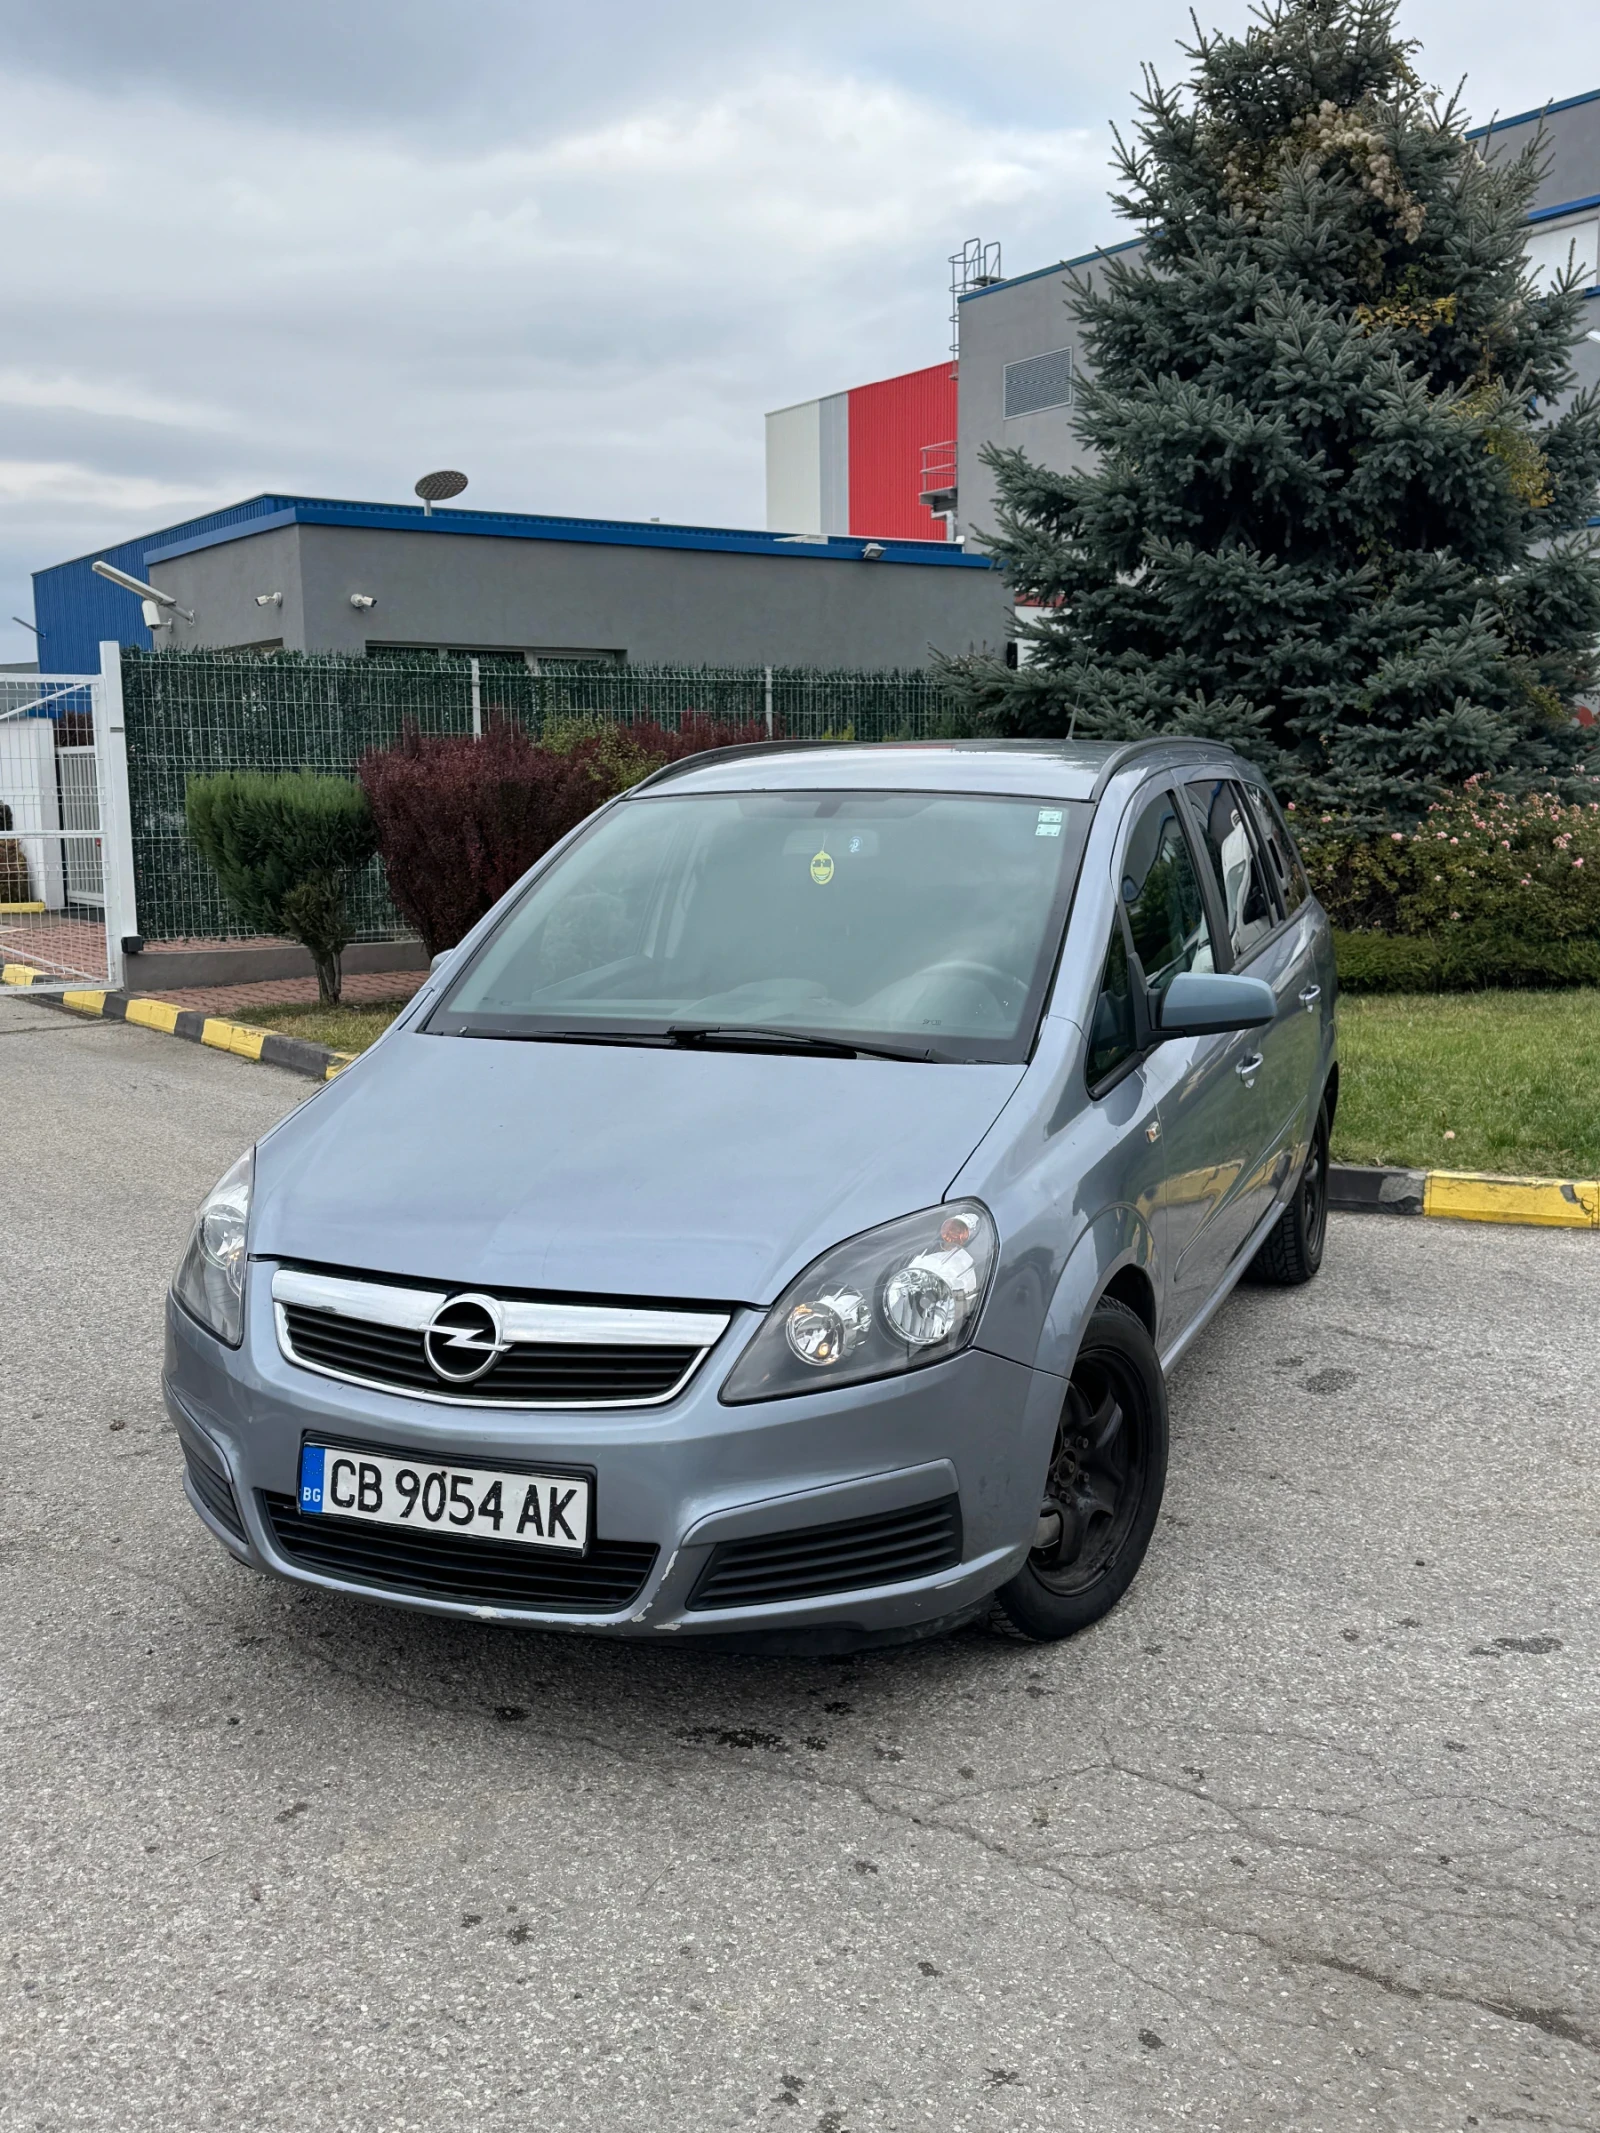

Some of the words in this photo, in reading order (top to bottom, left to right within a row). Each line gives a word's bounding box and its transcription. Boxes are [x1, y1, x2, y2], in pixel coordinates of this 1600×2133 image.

[302, 1487, 321, 1503] BG
[330, 1458, 383, 1513] CB
[395, 1468, 504, 1531] 9054
[516, 1484, 577, 1540] AK
